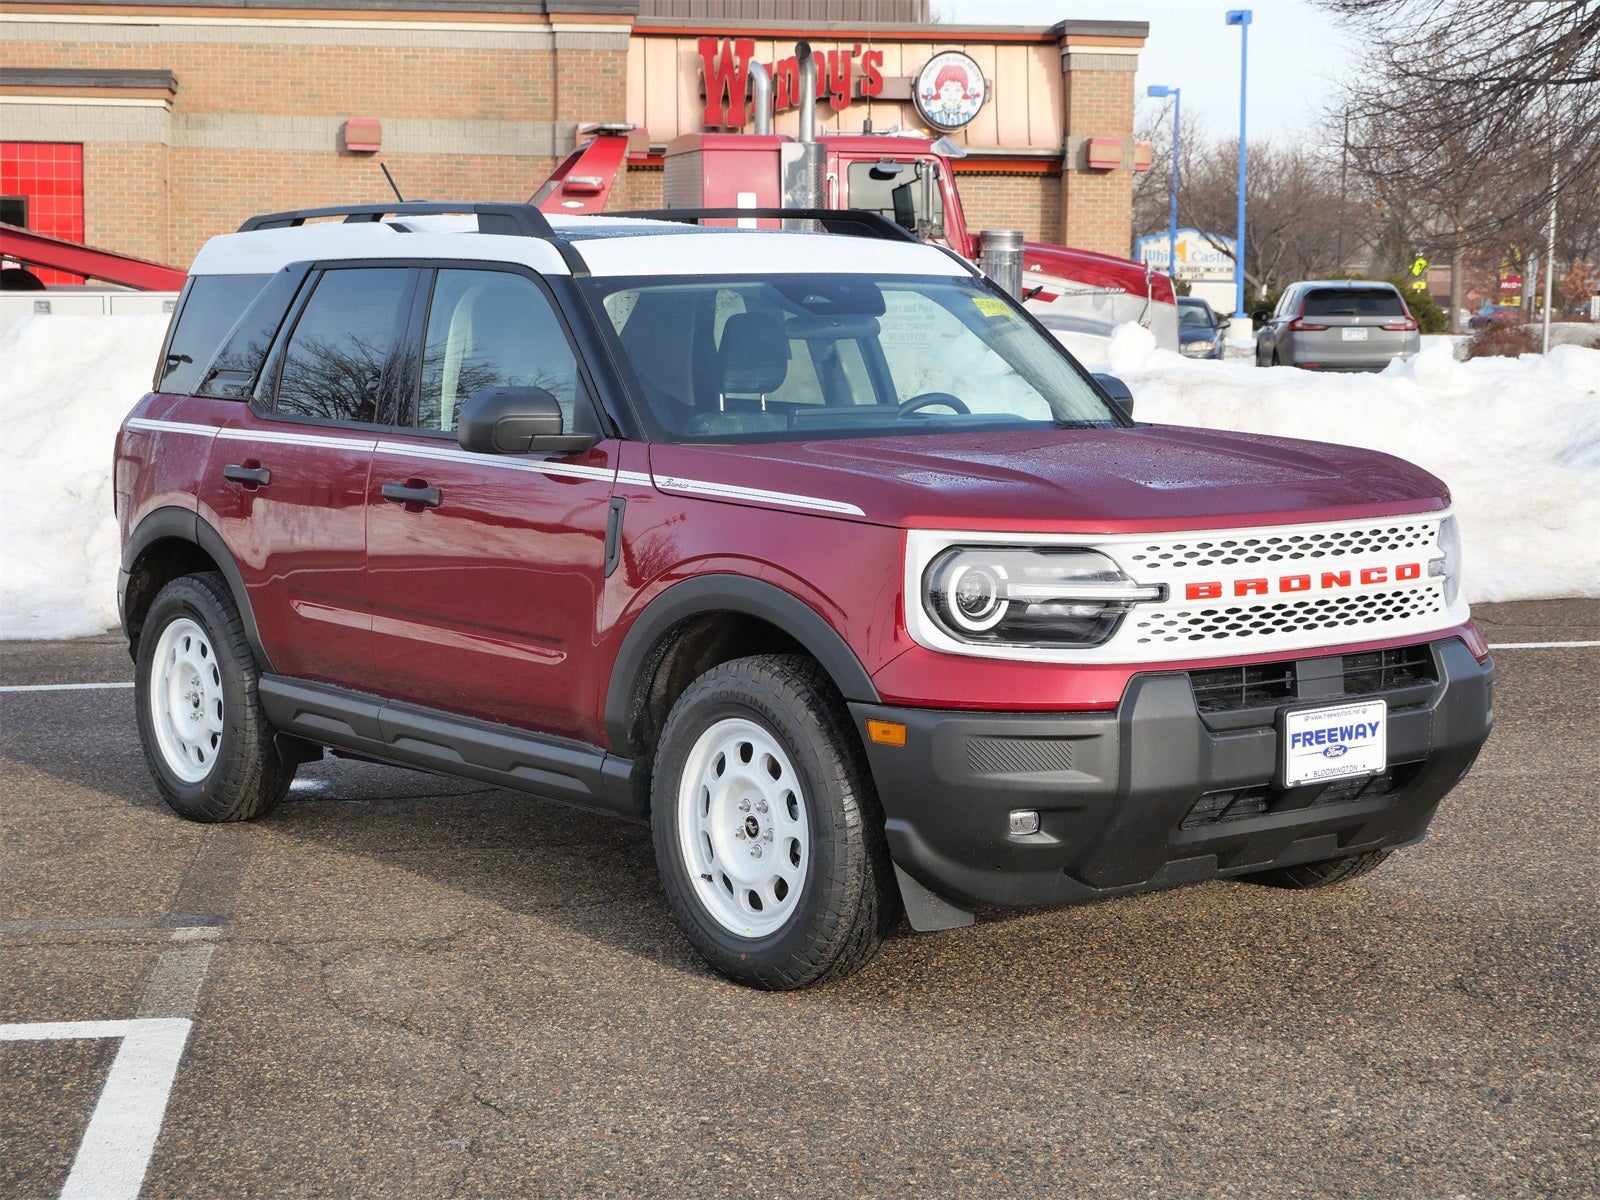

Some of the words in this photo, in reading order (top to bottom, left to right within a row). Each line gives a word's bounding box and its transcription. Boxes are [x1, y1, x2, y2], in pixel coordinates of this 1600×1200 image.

[697, 37, 884, 127] Wny's
[1144, 250, 1180, 263] Whie
[661, 478, 690, 489] Bronco
[1186, 563, 1420, 600] BRONCO
[1291, 721, 1380, 749] FREEWAY
[1325, 745, 1346, 757] Ford
[1313, 765, 1358, 777] BLOOMINGTON
